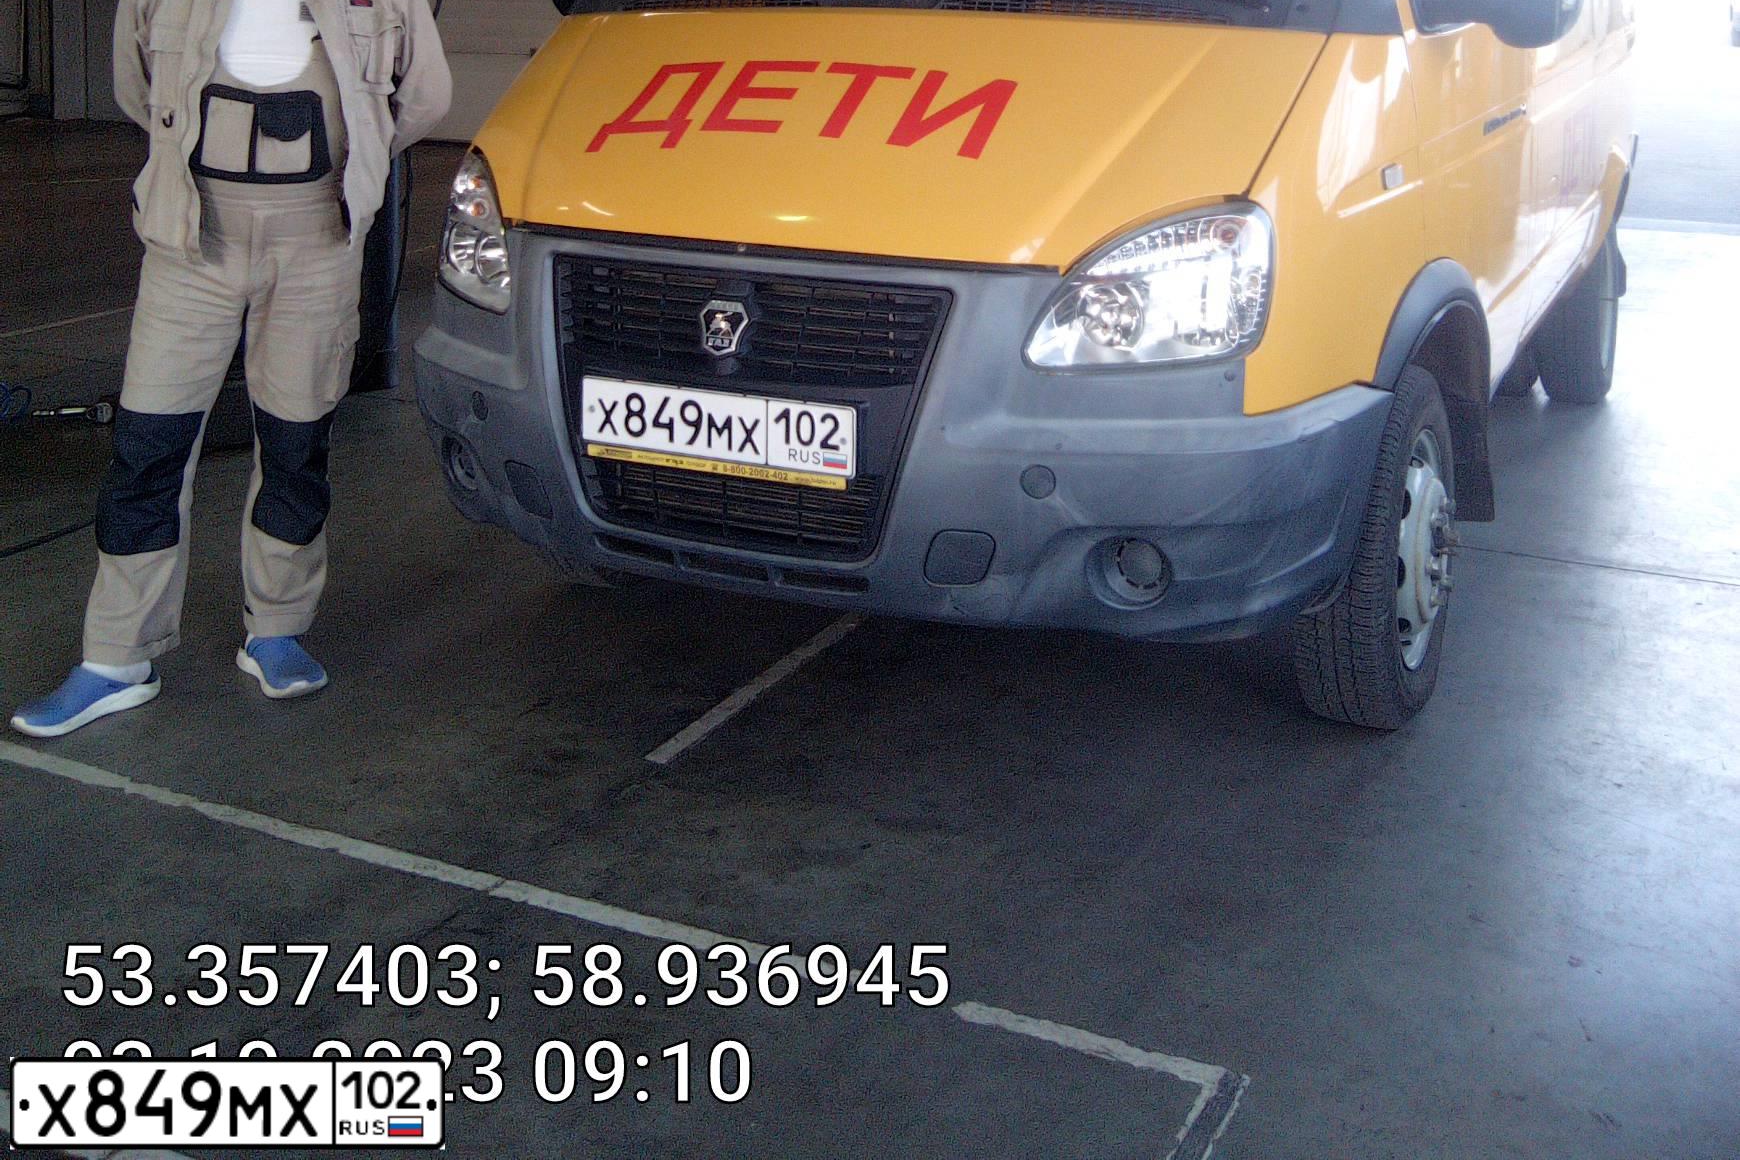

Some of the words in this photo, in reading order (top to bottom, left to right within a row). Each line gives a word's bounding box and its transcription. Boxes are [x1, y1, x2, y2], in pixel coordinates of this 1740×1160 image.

[584, 60, 1018, 160] ДЕТИ
[597, 392, 761, 455] Х849МХ
[774, 407, 840, 451] 102
[788, 448, 821, 465] RUS
